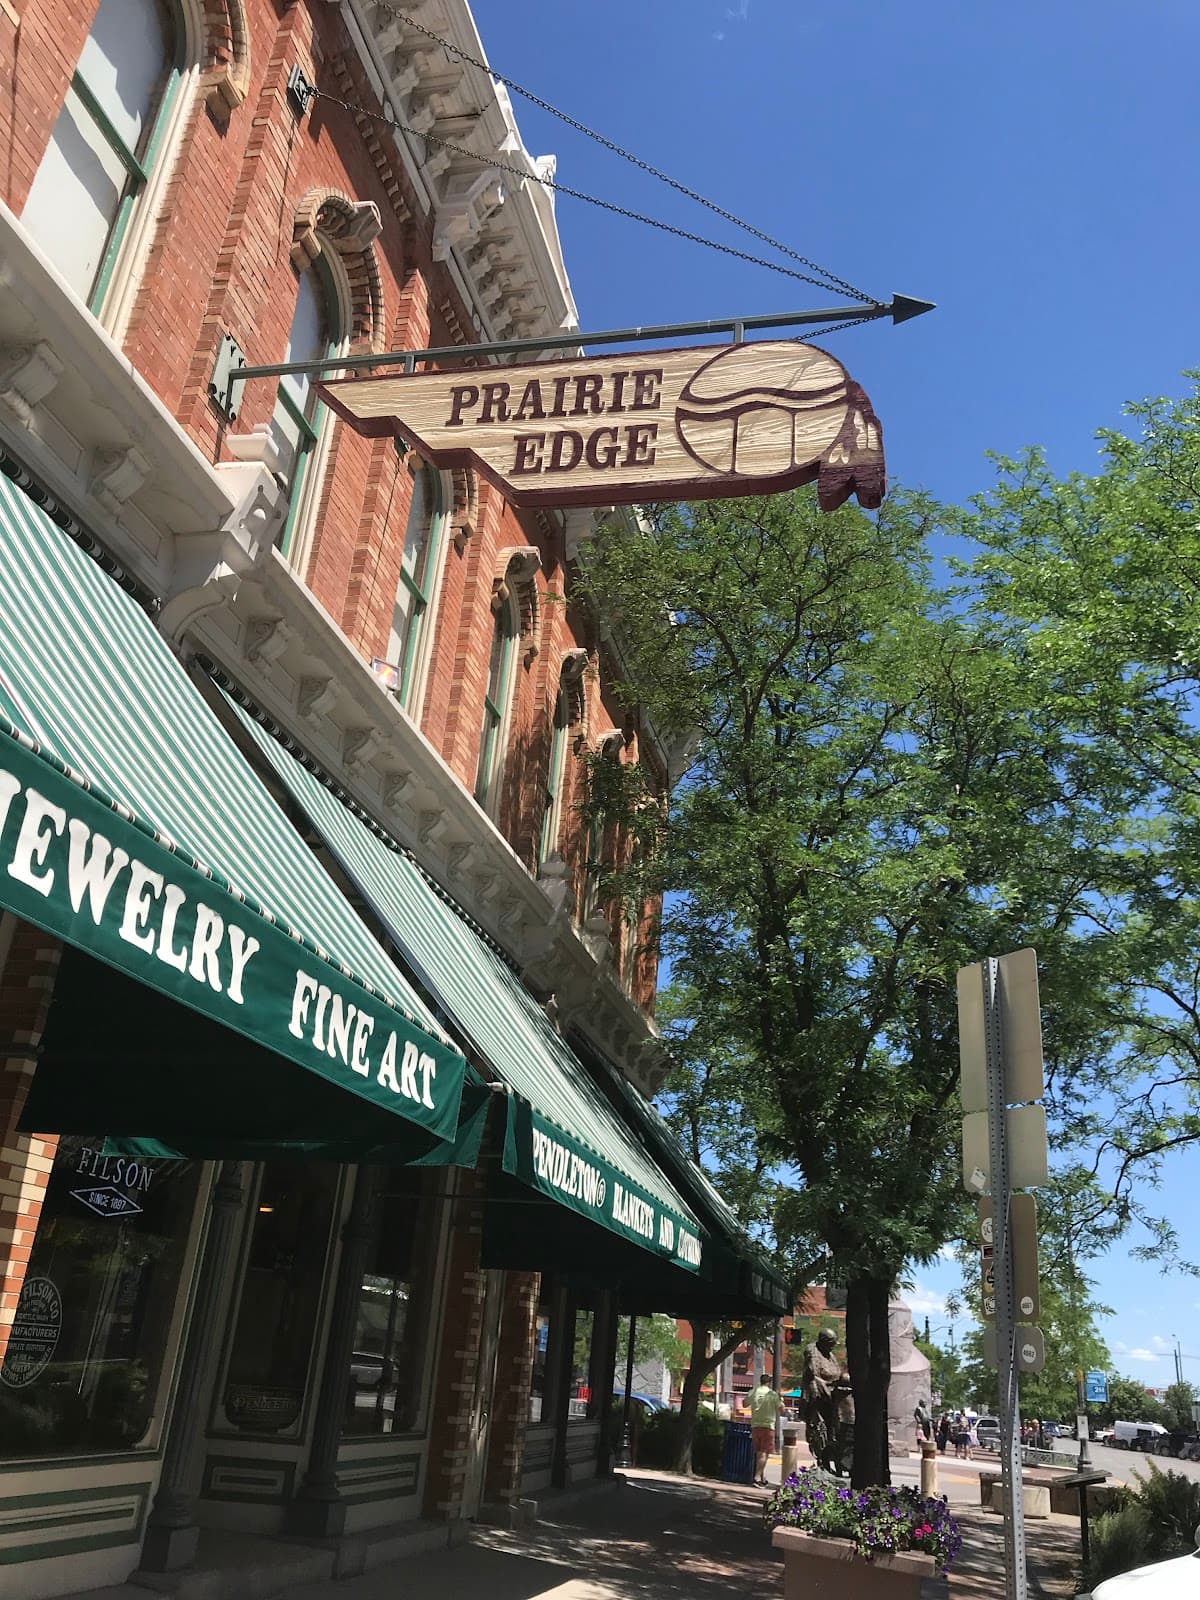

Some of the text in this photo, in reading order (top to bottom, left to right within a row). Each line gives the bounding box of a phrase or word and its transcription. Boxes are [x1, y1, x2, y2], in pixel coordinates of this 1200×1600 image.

[445, 368, 664, 427] PRAIRIE
[509, 423, 659, 476] EDGE
[288, 969, 437, 1110] FINE ART
[76, 1147, 154, 1192] FILSON
[110, 1197, 126, 1210] 1897
[612, 1182, 654, 1240] BLANKETS
[659, 1214, 674, 1251] AND
